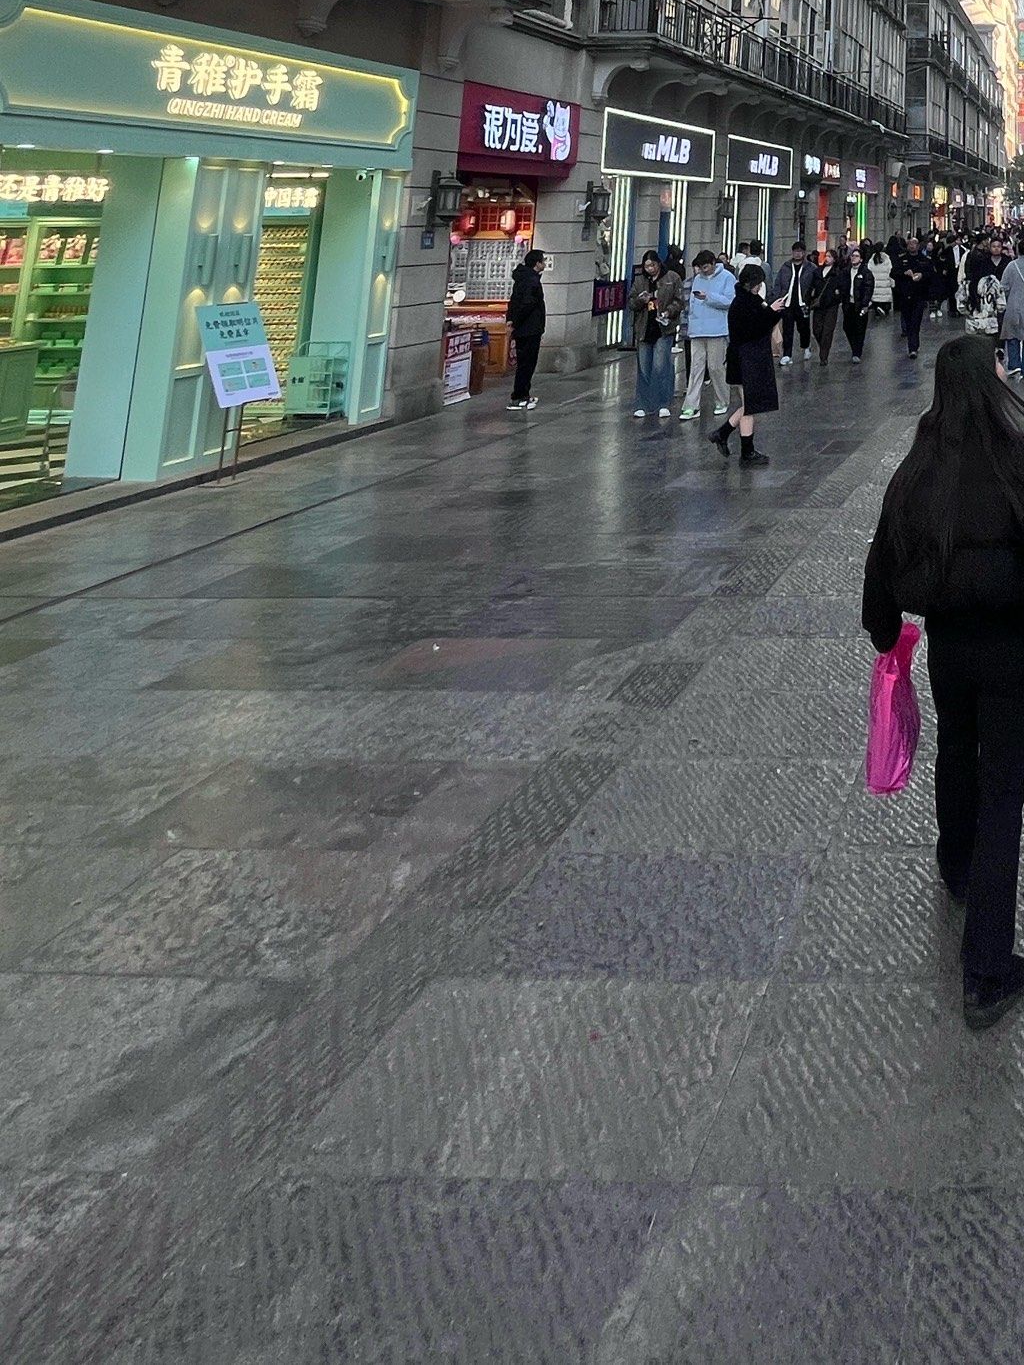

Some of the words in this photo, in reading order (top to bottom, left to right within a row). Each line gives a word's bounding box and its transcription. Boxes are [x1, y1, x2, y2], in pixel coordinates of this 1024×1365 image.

[166, 97, 224, 119] QINGZHI
[224, 104, 262, 124] HAND
[261, 109, 303, 128] CREAM
[656, 134, 691, 165] MLB
[757, 153, 779, 177] MLB
